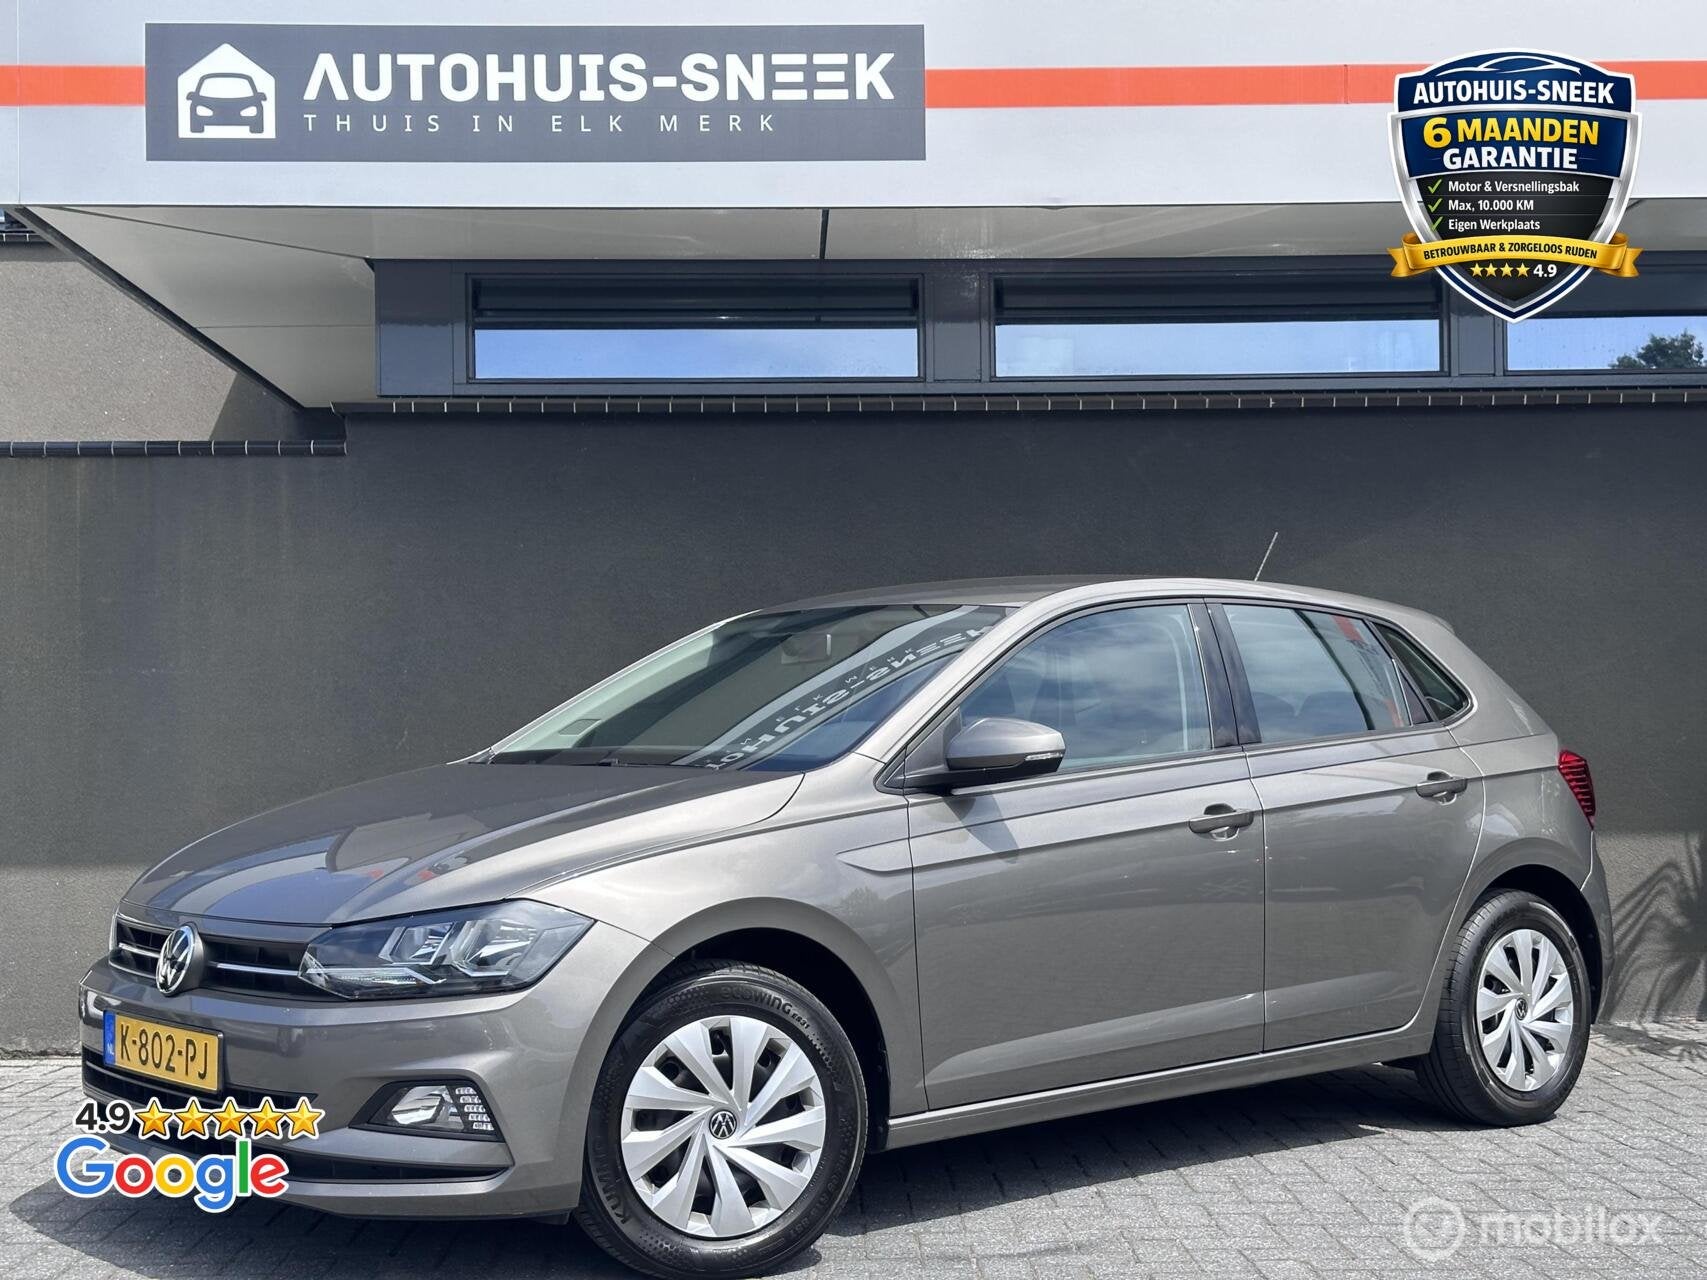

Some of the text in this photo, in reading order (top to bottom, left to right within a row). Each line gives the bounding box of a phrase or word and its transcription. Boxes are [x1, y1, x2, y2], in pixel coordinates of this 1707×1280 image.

[303, 52, 895, 103] AUTOHUIS-SNEEK
[303, 113, 774, 133] THUIS IN ELK MERK
[120, 1023, 208, 1080] K-802-PJ
